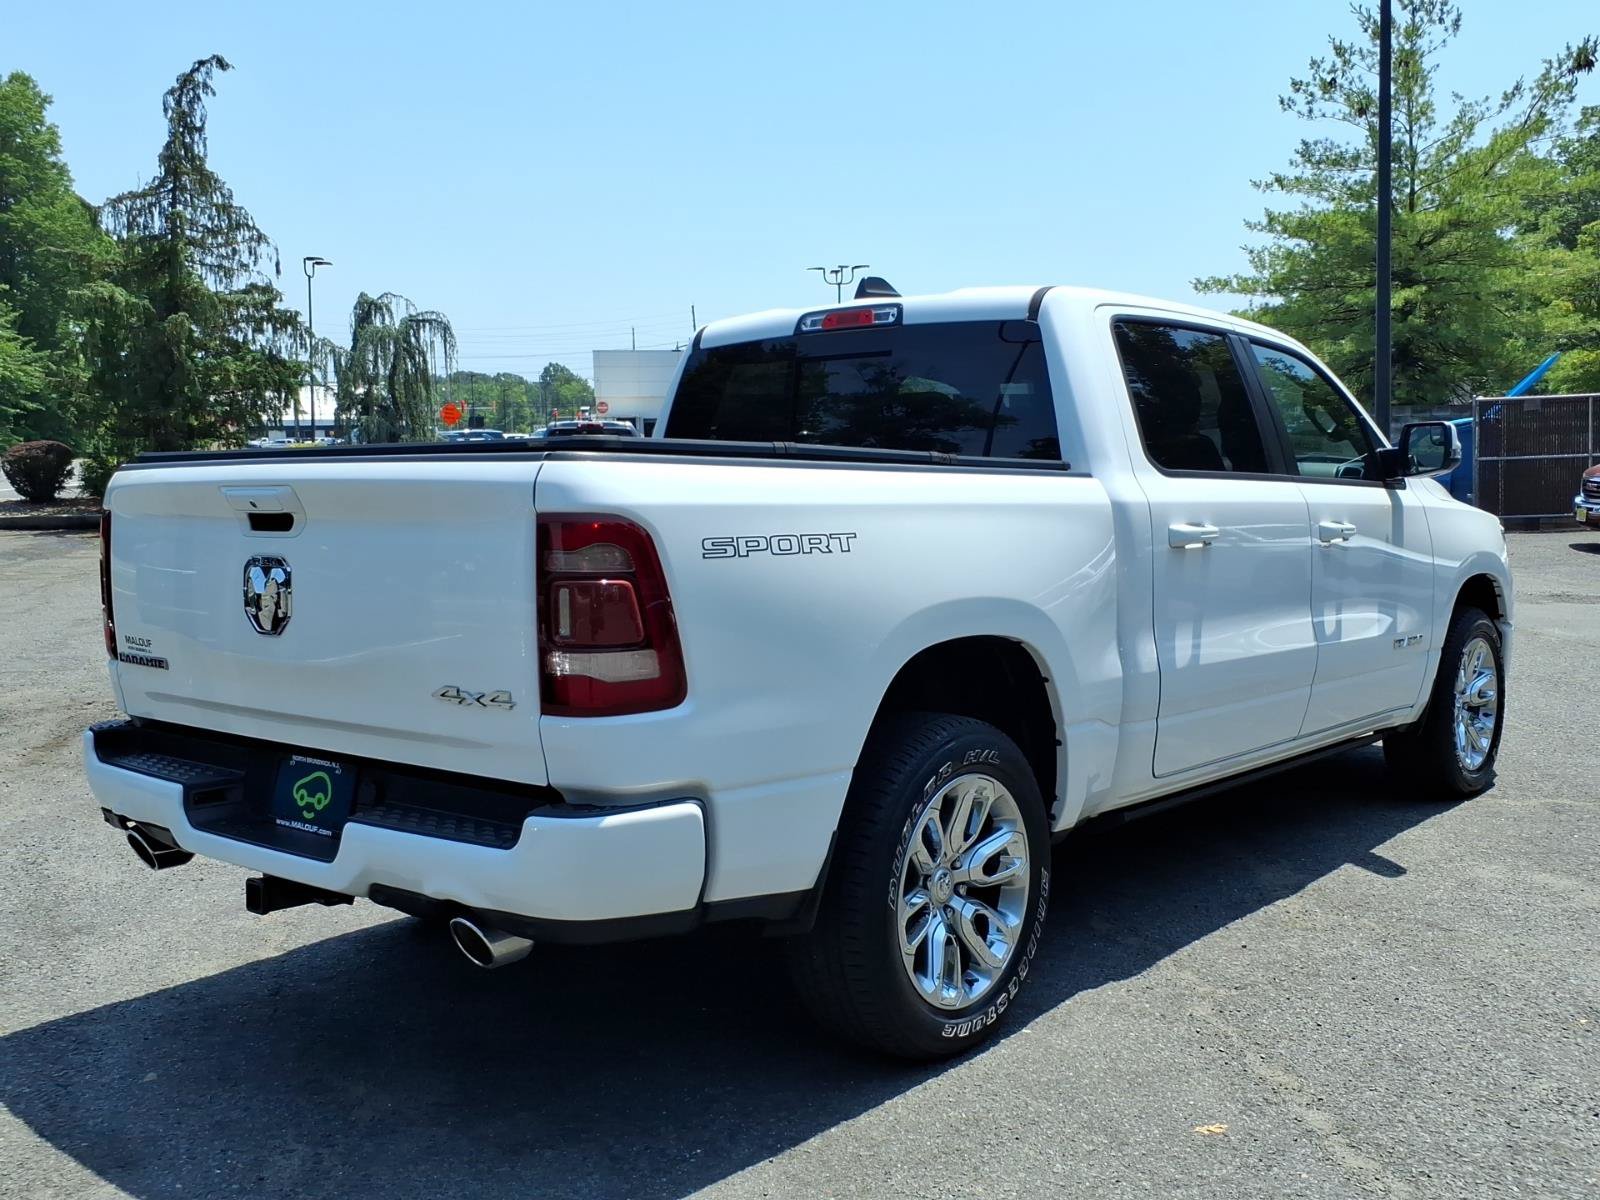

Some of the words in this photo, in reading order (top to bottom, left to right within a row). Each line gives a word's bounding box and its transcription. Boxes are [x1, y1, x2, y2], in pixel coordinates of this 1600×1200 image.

[702, 532, 857, 559] SPORT
[124, 634, 152, 648] MALOUF
[432, 685, 517, 710] 4x4
[942, 867, 1049, 1038] BRIDGESTONE
